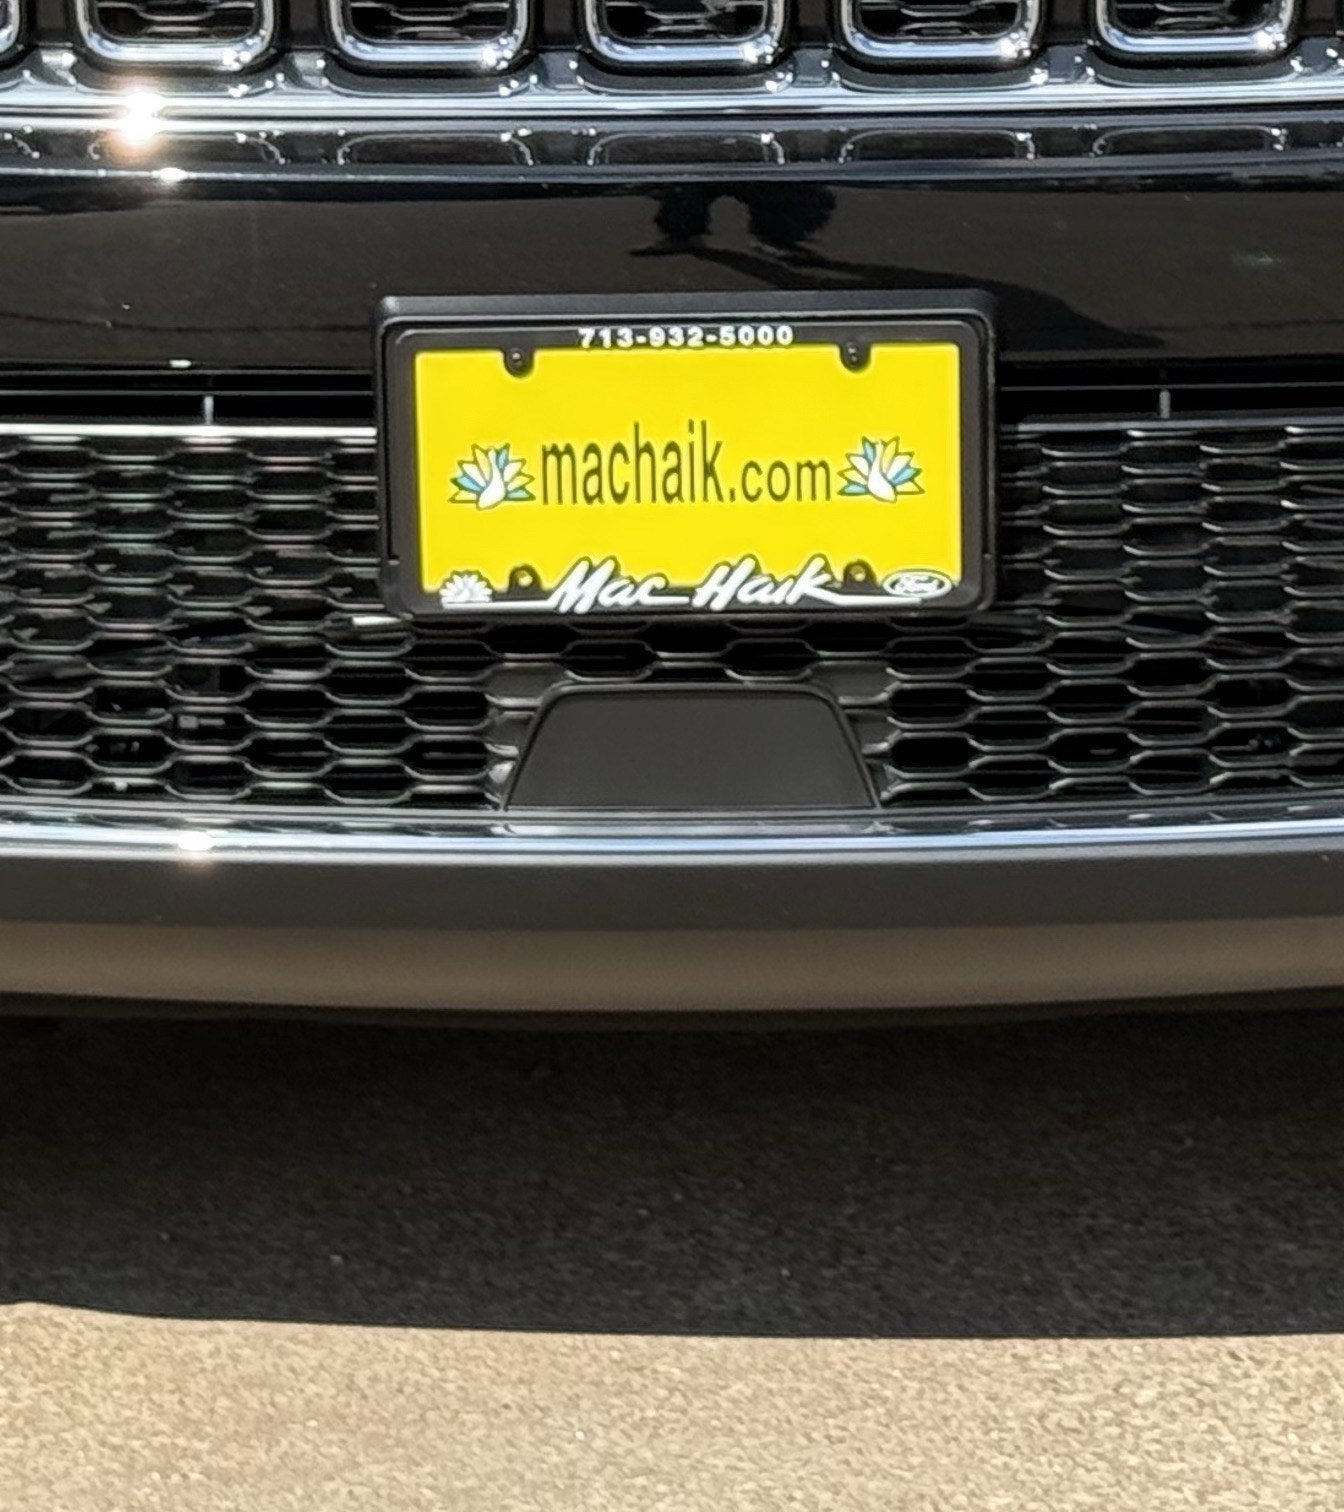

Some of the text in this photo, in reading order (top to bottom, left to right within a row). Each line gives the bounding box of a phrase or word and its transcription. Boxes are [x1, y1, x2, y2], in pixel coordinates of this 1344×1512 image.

[577, 325, 794, 349] 713-932-5000
[540, 418, 832, 505] machaik.com
[552, 554, 840, 613] Mac Haik
